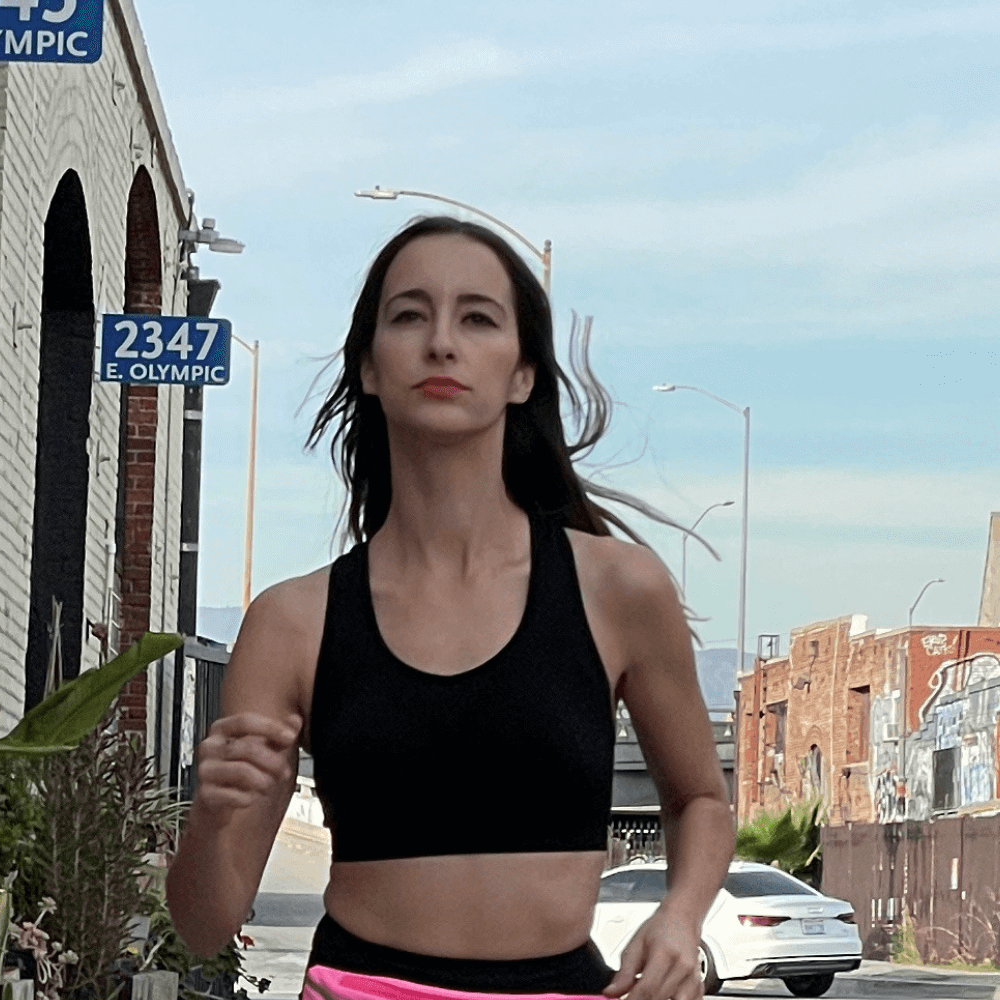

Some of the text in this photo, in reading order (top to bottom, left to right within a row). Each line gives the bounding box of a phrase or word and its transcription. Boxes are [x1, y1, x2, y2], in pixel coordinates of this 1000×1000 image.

[114, 320, 219, 361] 2347
[106, 363, 225, 382] E. OLYMPIC
